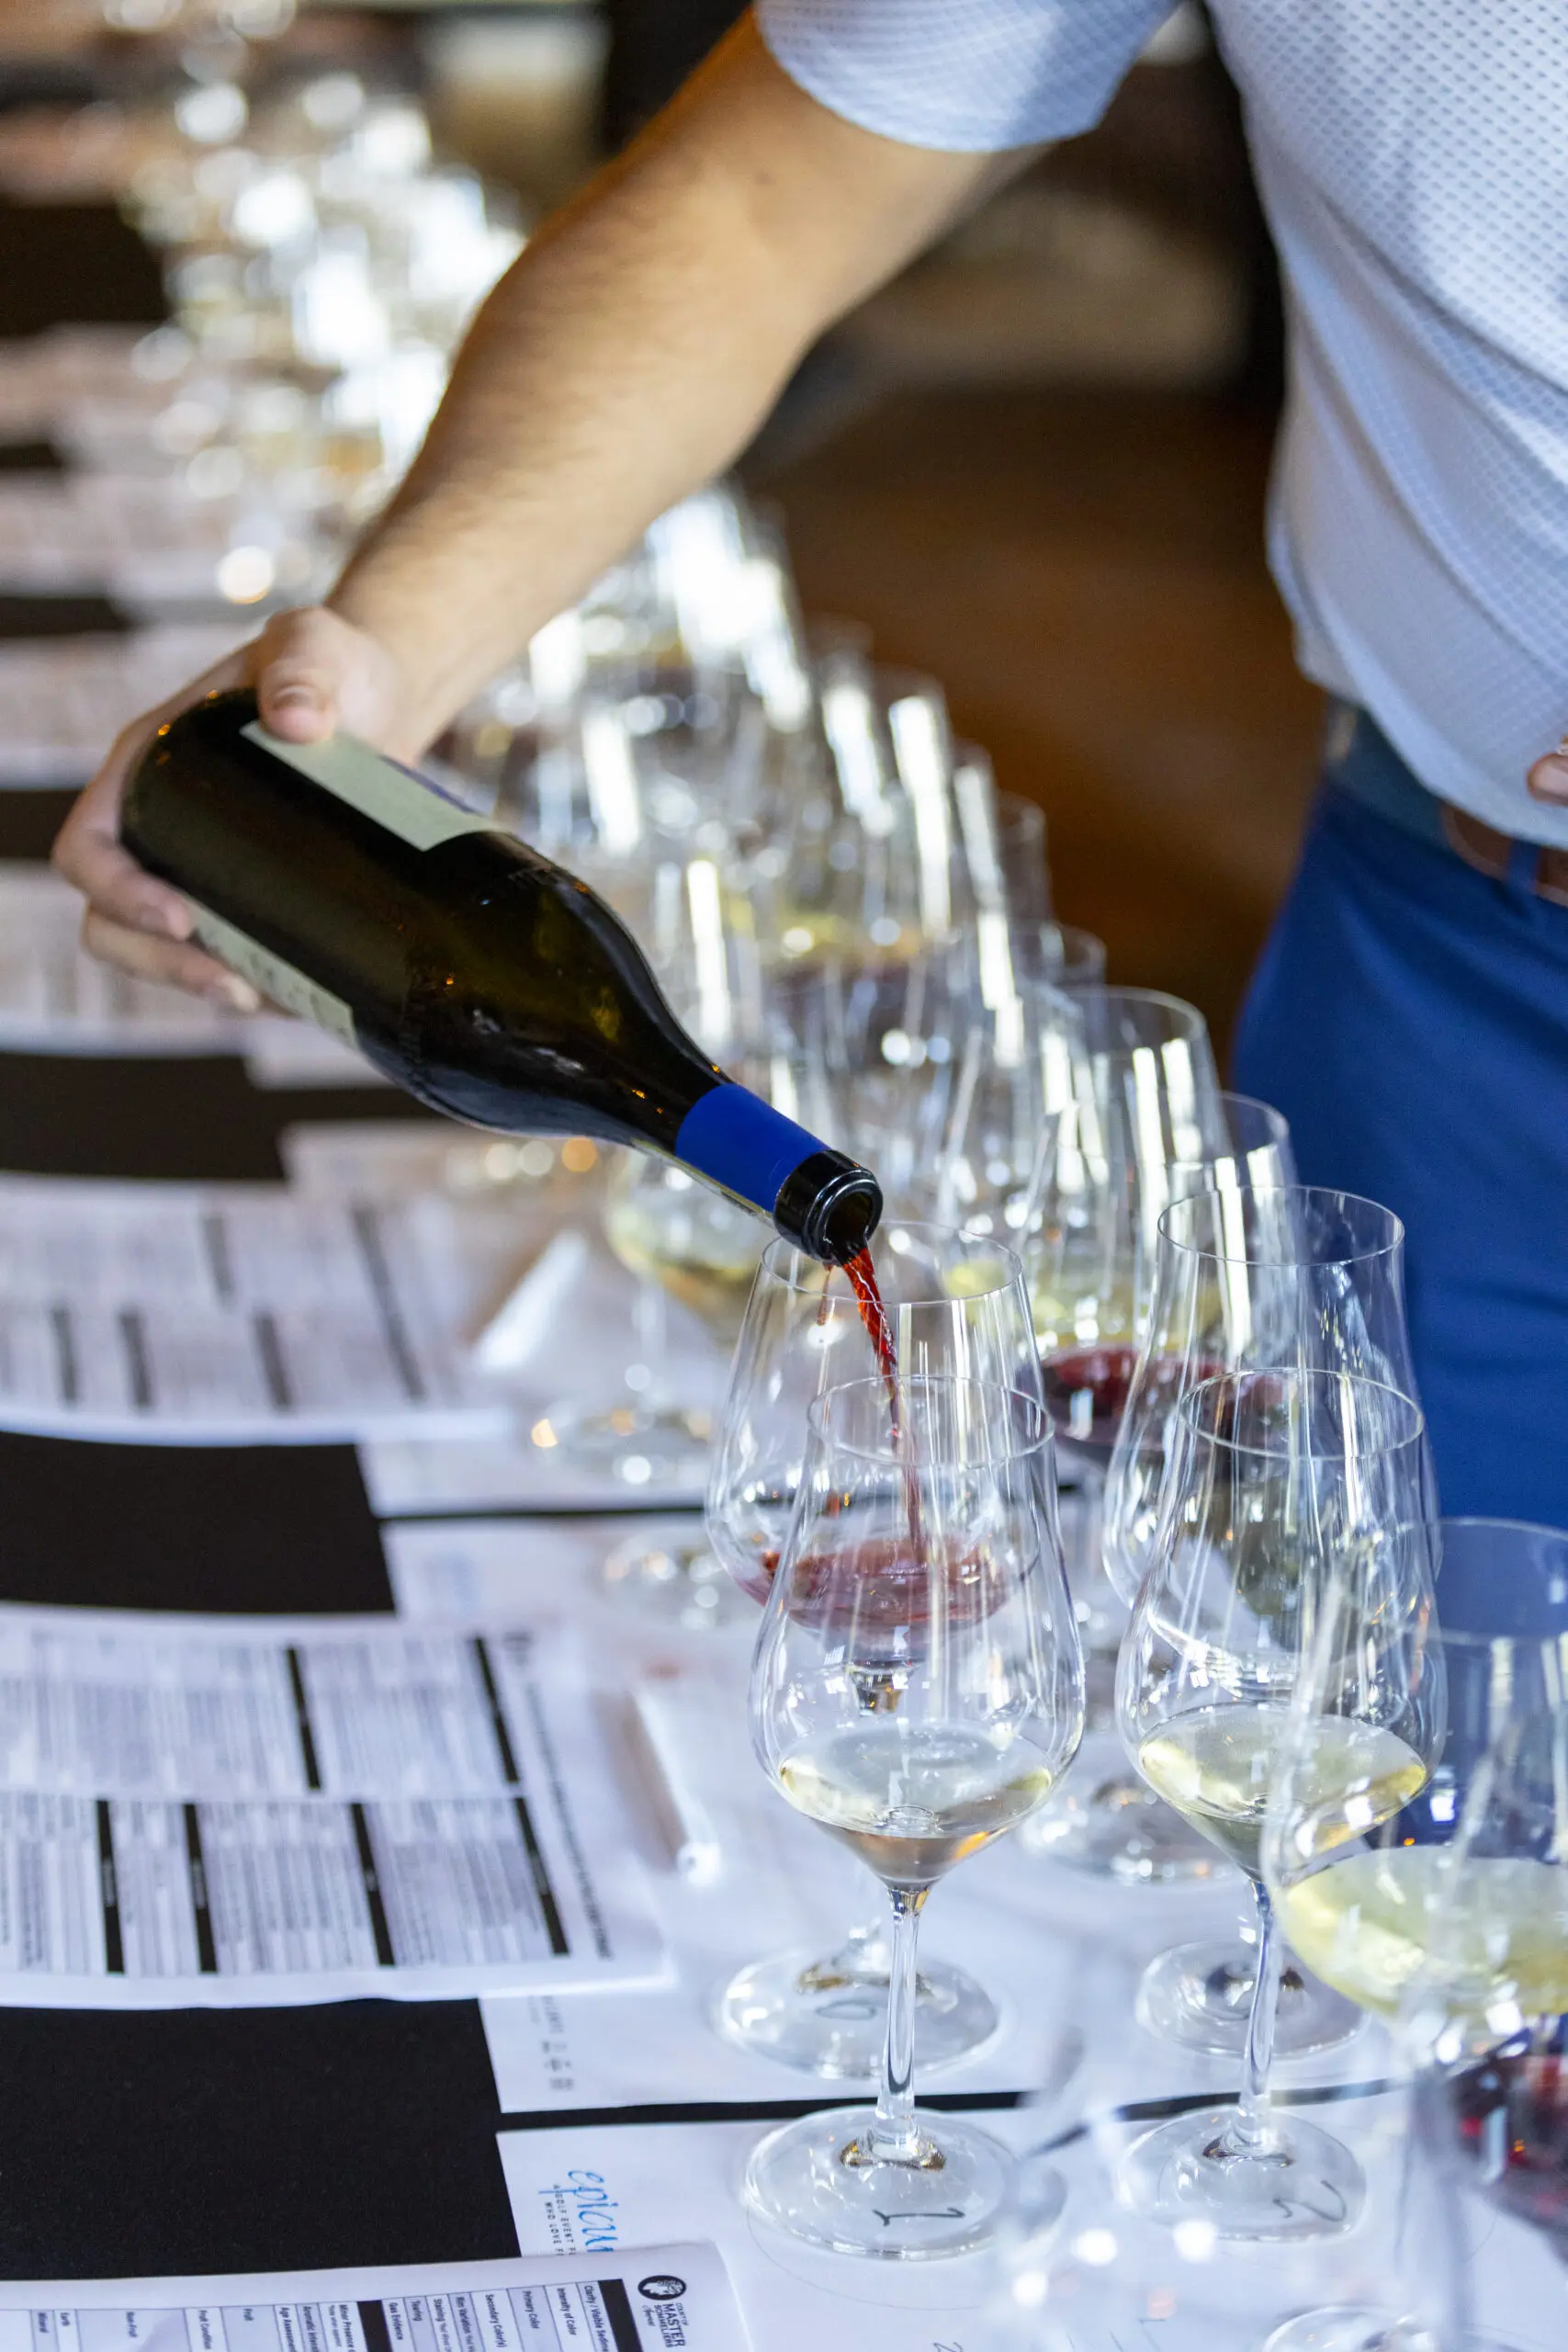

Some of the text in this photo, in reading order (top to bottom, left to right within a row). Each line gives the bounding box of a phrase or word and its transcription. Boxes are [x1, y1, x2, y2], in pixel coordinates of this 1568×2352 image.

[548, 2223, 562, 2245] LOVE
[560, 2217, 574, 2244] EVENT
[485, 2293, 500, 2324] Secondary
[522, 2290, 540, 2329] Primary Color
[557, 2288, 570, 2312] Intensity
[566, 2319, 577, 2335] Color
[591, 2308, 604, 2329] Visible
[653, 2304, 674, 2348] SOMMELIERS
[661, 2303, 685, 2347] MASTER
